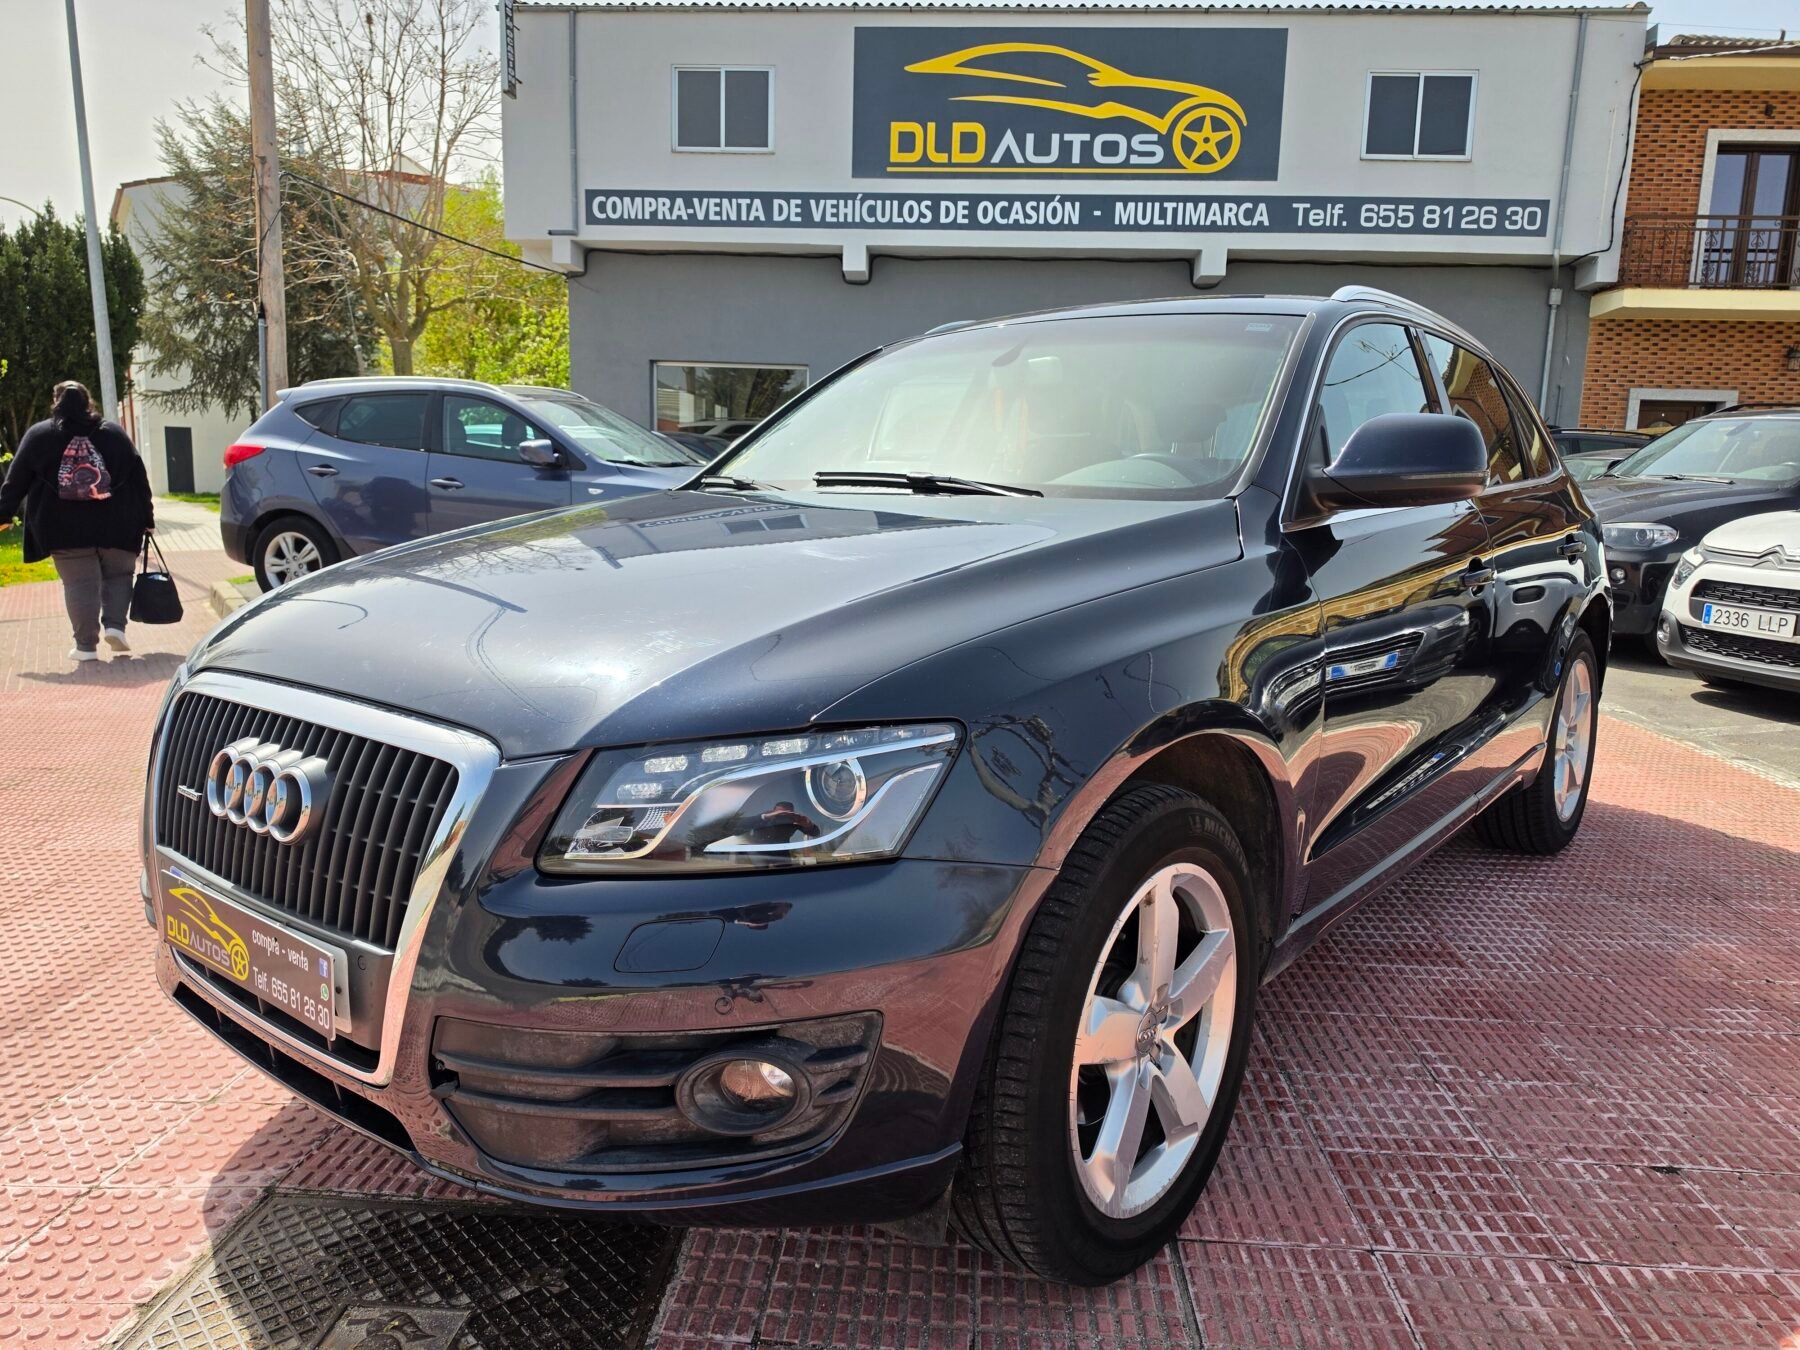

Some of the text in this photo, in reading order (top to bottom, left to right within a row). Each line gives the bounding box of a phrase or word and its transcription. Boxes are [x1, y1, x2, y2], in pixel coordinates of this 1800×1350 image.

[889, 121, 1165, 165] DLD AUTOS
[591, 195, 766, 222] COMPRA-VENTA
[772, 198, 802, 223] DE
[809, 194, 933, 224] VEHÍCULOS
[939, 200, 970, 225] DE
[976, 196, 1081, 226] OCASIÓN
[1114, 201, 1270, 227] MULTIMARCA
[1292, 202, 1348, 228] Telf.
[1359, 203, 1415, 229] 655
[1422, 204, 1455, 230] 81
[1460, 205, 1498, 230] 26
[1504, 206, 1542, 231] 30
[1713, 608, 1788, 634] 2336 LLP
[167, 914, 230, 967] DLD AUTOS
[252, 929, 279, 957] compra
[287, 948, 309, 972] venta
[252, 966, 330, 1030] Telf. 655 81 26 30
